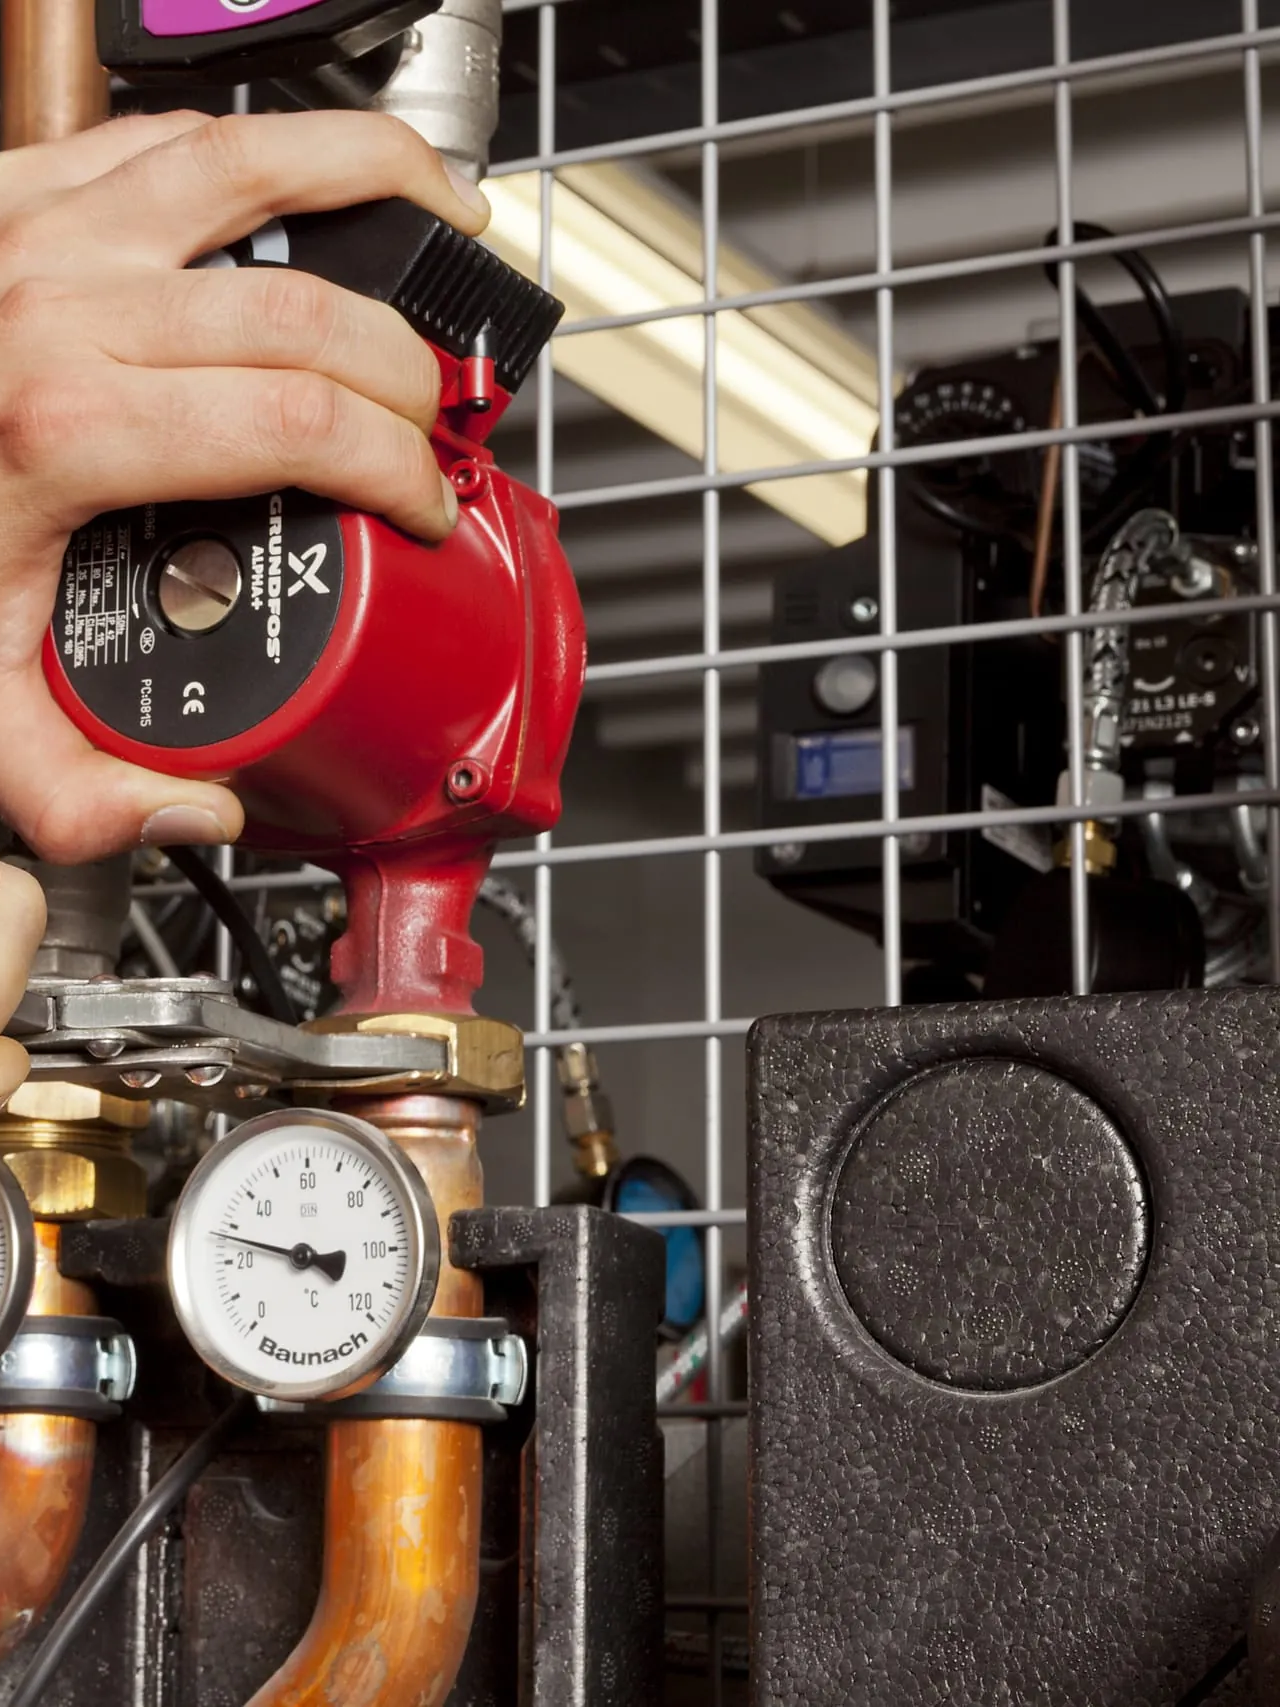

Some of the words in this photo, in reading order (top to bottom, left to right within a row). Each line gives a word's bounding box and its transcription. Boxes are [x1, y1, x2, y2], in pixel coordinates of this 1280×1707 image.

[251, 545, 264, 610] ALPHA+
[267, 494, 282, 657] GRUNDFOS
[140, 678, 152, 726] PC:0815
[300, 1172, 316, 1190] 60
[256, 1200, 272, 1217] 40
[347, 1191, 363, 1208] 80
[363, 1241, 386, 1259] 100
[237, 1251, 253, 1269] 20
[304, 1288, 319, 1308] °C
[348, 1293, 372, 1311] 120
[258, 1301, 265, 1318] 0
[258, 1331, 368, 1365] Baunach
